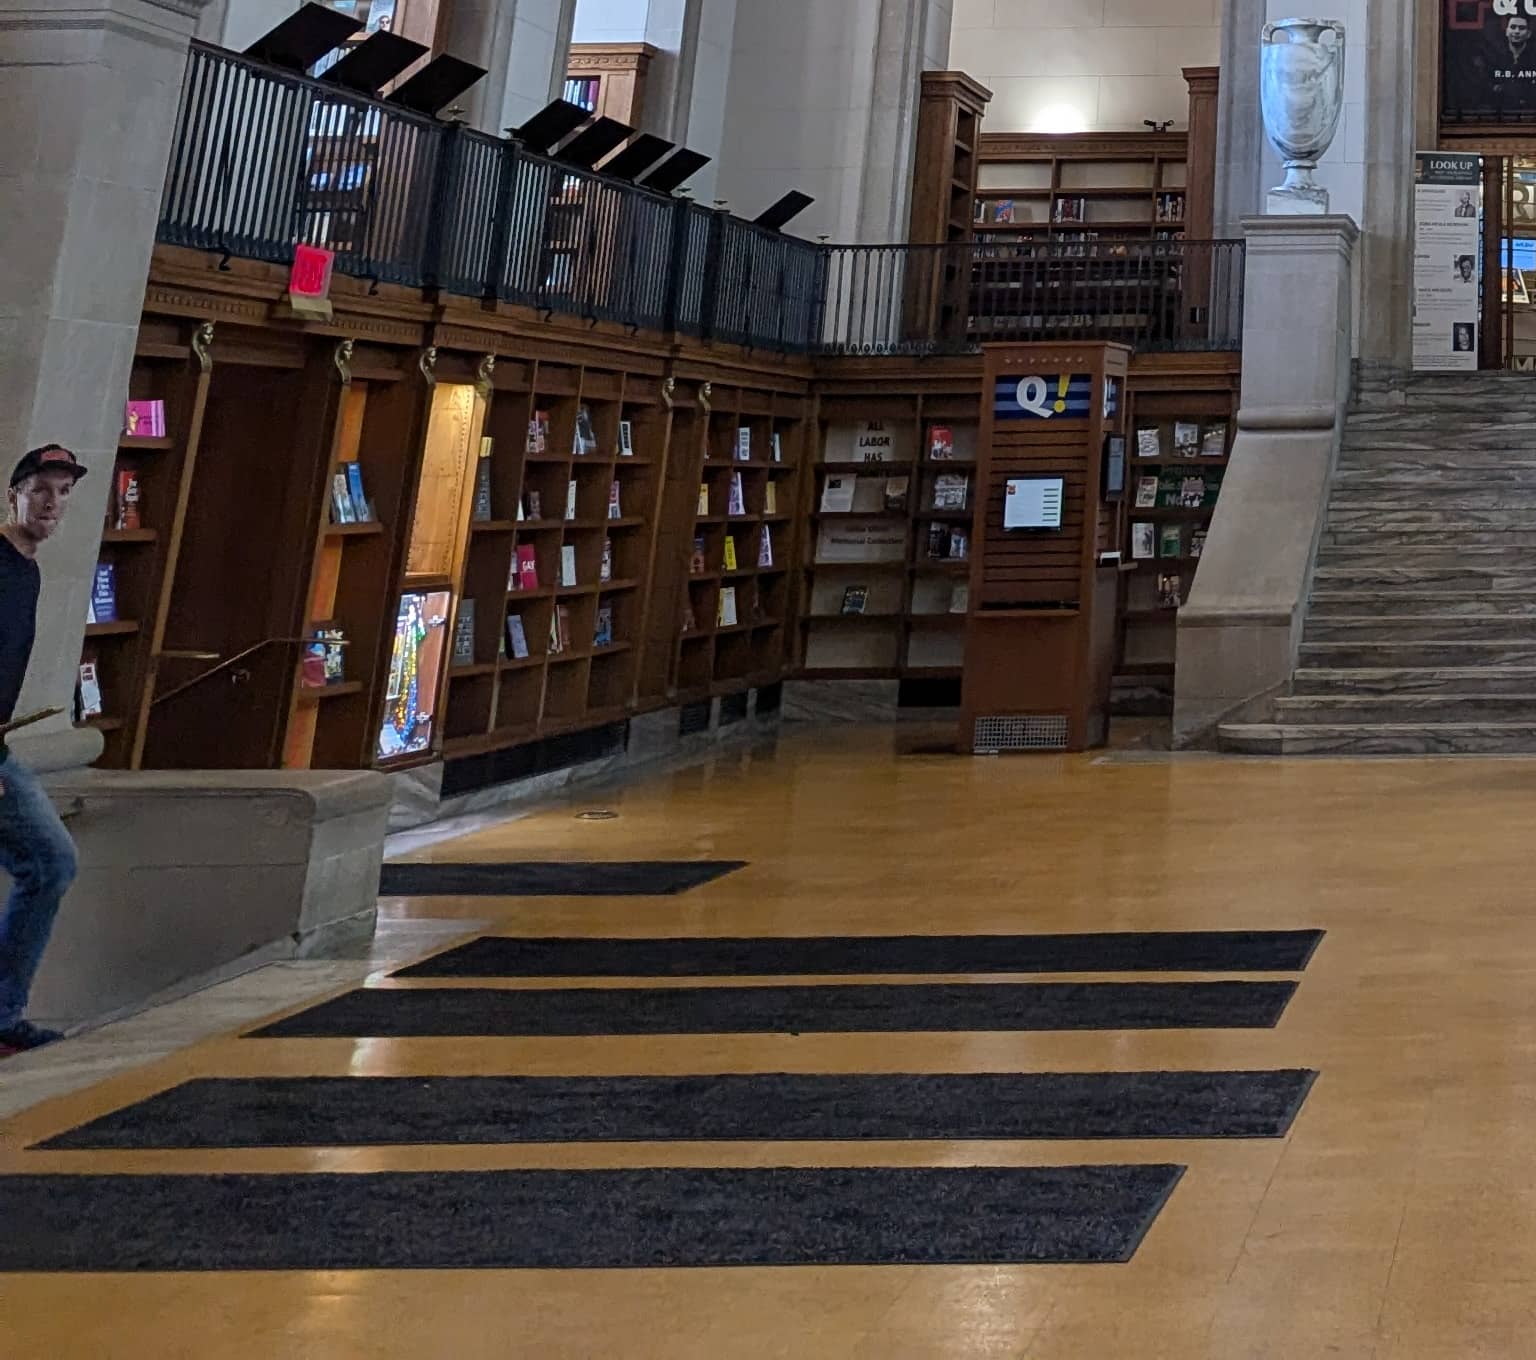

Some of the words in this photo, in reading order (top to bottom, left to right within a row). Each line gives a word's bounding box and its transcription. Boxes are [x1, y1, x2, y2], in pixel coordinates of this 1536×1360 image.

[1430, 160, 1458, 170] LOOK
[1460, 161, 1474, 170] UP
[859, 436, 890, 447] LABOR
[864, 452, 883, 463] HAS
